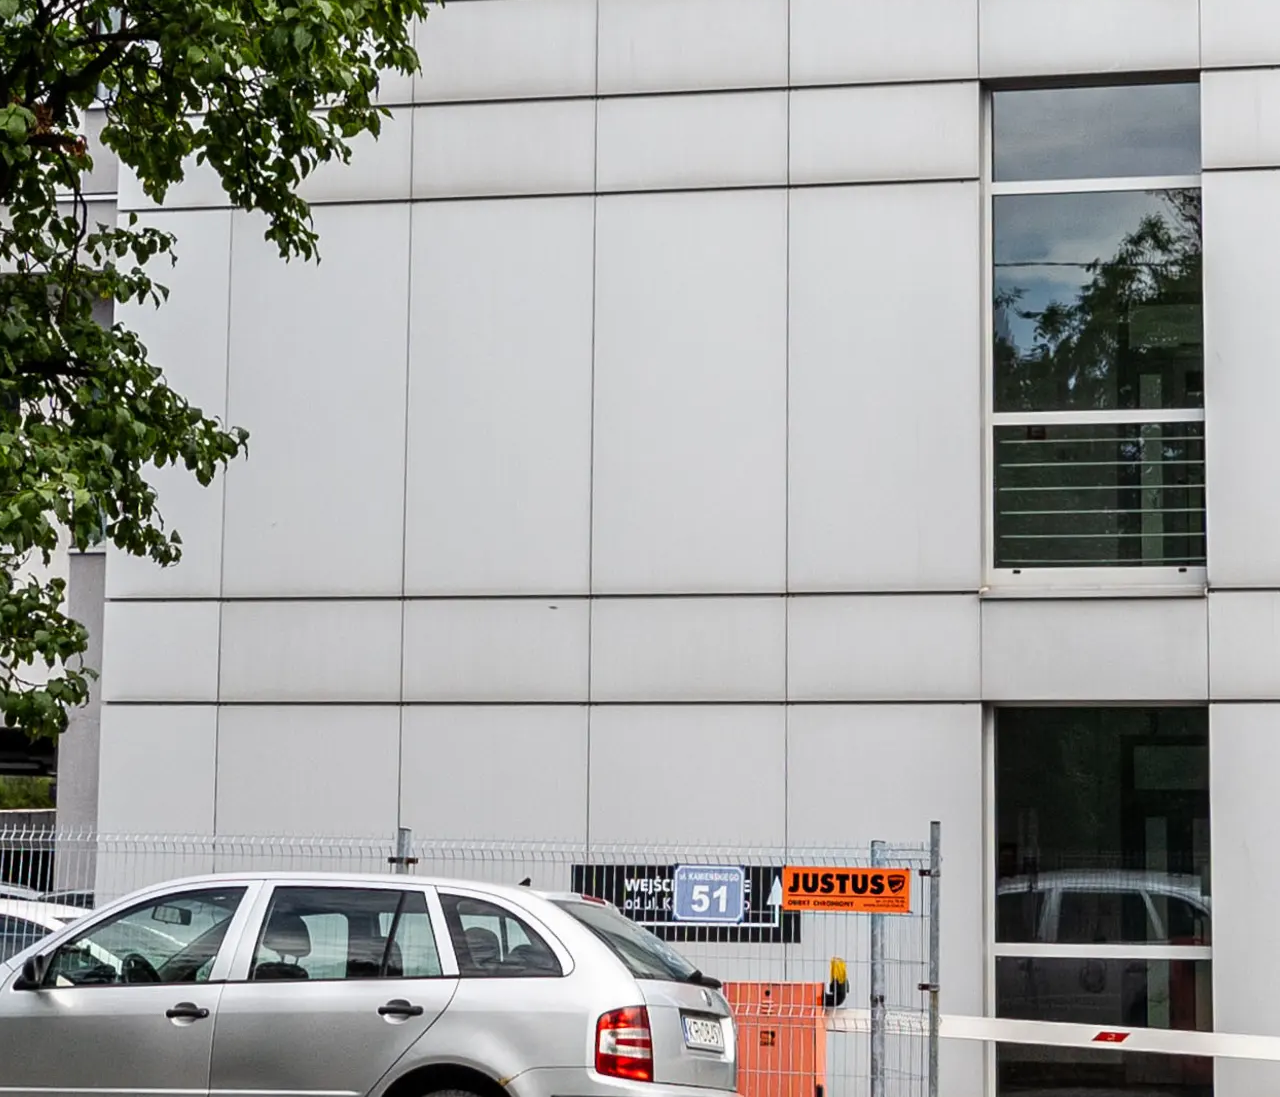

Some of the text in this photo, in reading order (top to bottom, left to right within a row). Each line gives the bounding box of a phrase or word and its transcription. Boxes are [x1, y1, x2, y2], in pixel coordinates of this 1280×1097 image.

[624, 876, 675, 895] WEJŚCI
[788, 873, 885, 895] JUSTUS
[624, 897, 641, 910] od
[644, 898, 659, 910] ul.
[690, 885, 728, 913] 51
